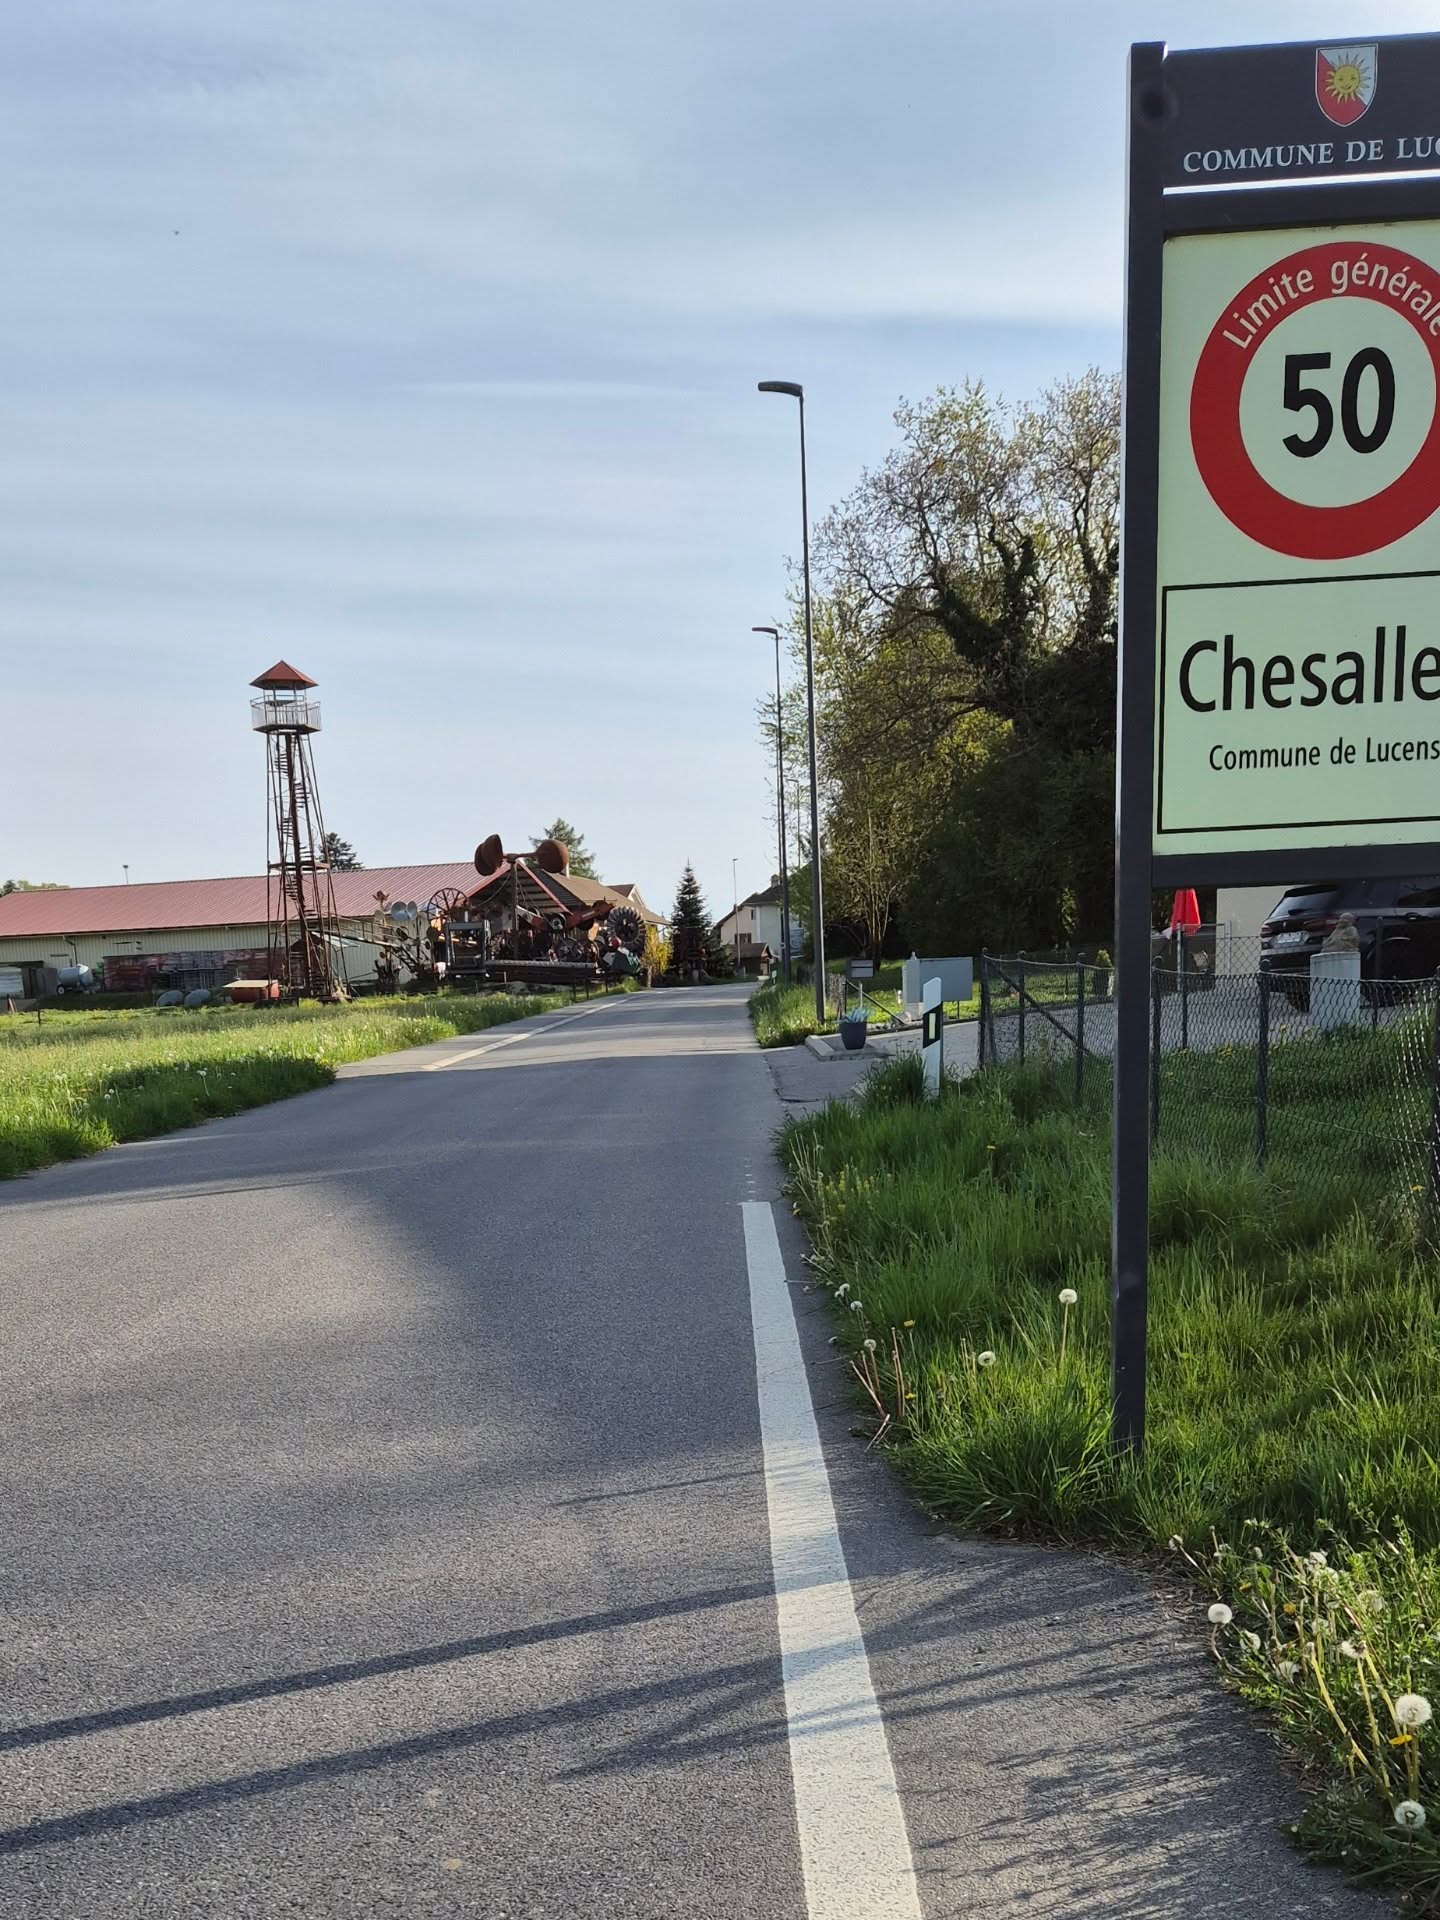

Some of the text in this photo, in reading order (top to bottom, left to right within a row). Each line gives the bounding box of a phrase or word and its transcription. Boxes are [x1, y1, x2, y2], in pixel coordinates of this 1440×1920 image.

[1183, 142, 1334, 173] COMMUNE
[1345, 140, 1384, 162] DE
[1222, 252, 1440, 350] Limite générale
[1282, 346, 1396, 459] 50
[1209, 736, 1440, 770] Commune de Lucens
